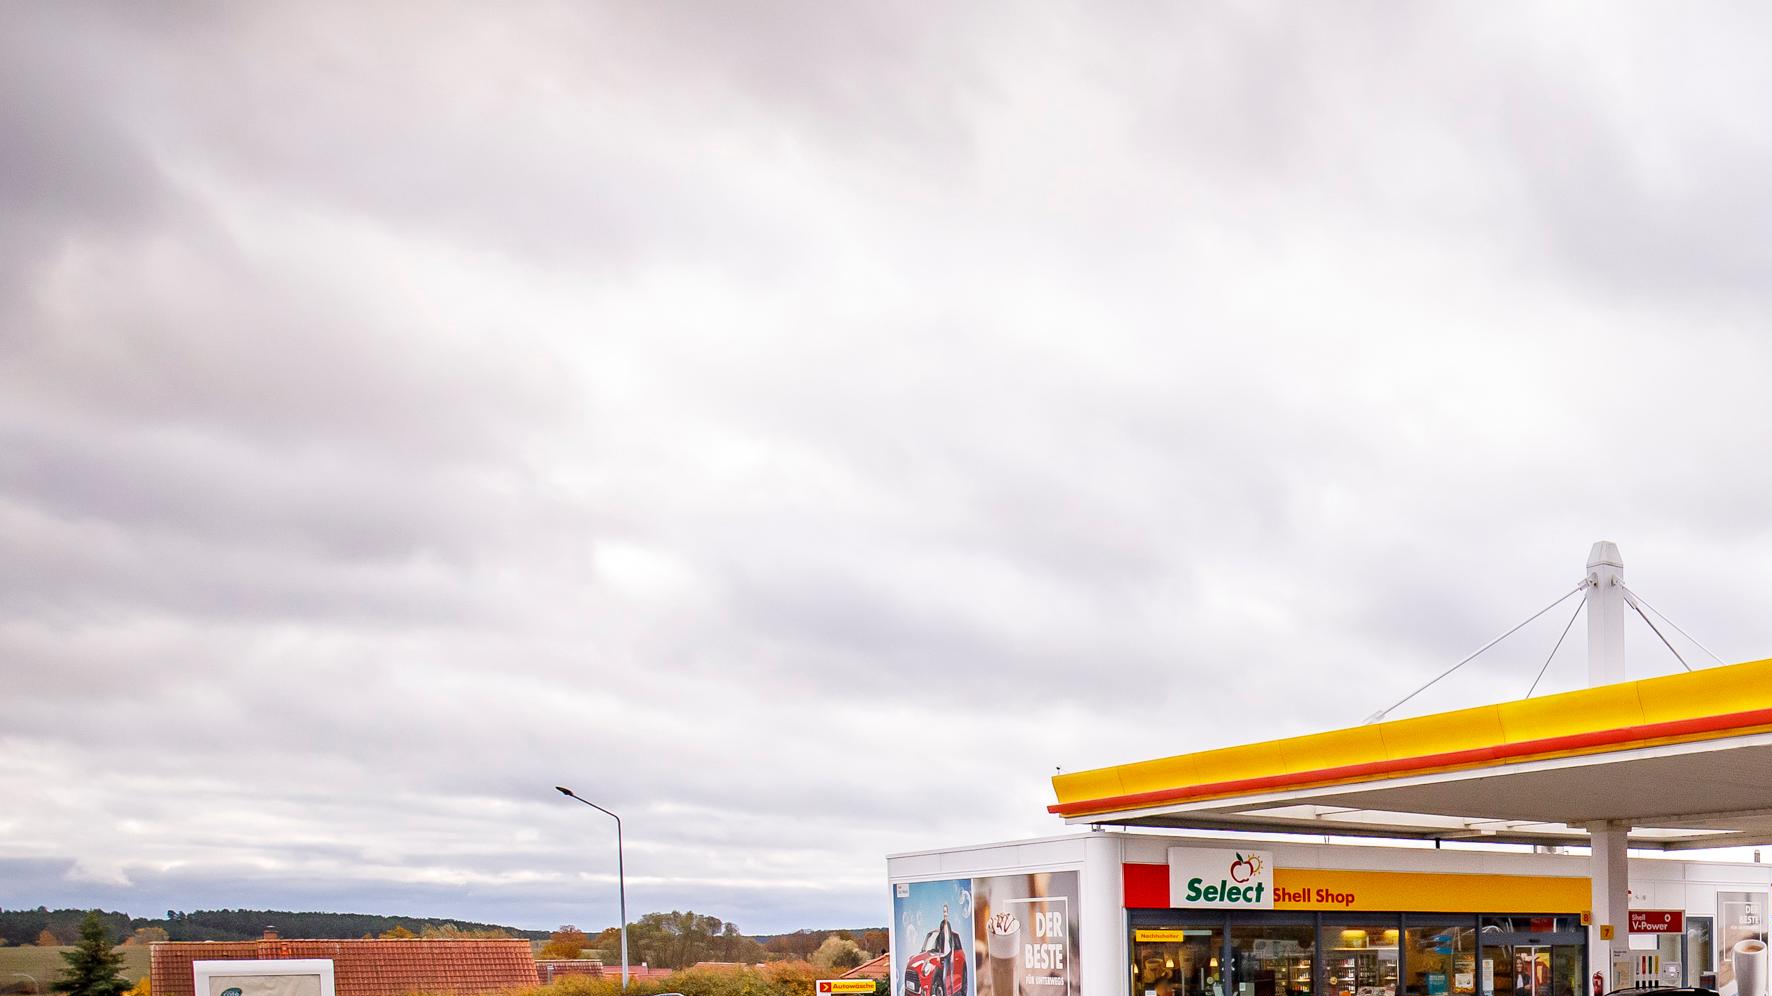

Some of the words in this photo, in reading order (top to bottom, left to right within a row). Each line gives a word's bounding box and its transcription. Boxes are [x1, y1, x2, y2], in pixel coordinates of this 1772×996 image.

[1185, 877, 1264, 903] Select
[1273, 887, 1311, 904] Shell
[1316, 888, 1355, 907] Shop
[1036, 912, 1063, 938] DER
[1583, 914, 1589, 922] 8
[1604, 929, 1609, 937] 7
[1632, 921, 1668, 931] V-Power
[1025, 943, 1064, 970] BESTE
[1025, 975, 1036, 986] FÜR
[1036, 976, 1064, 986] UNTERWEGS
